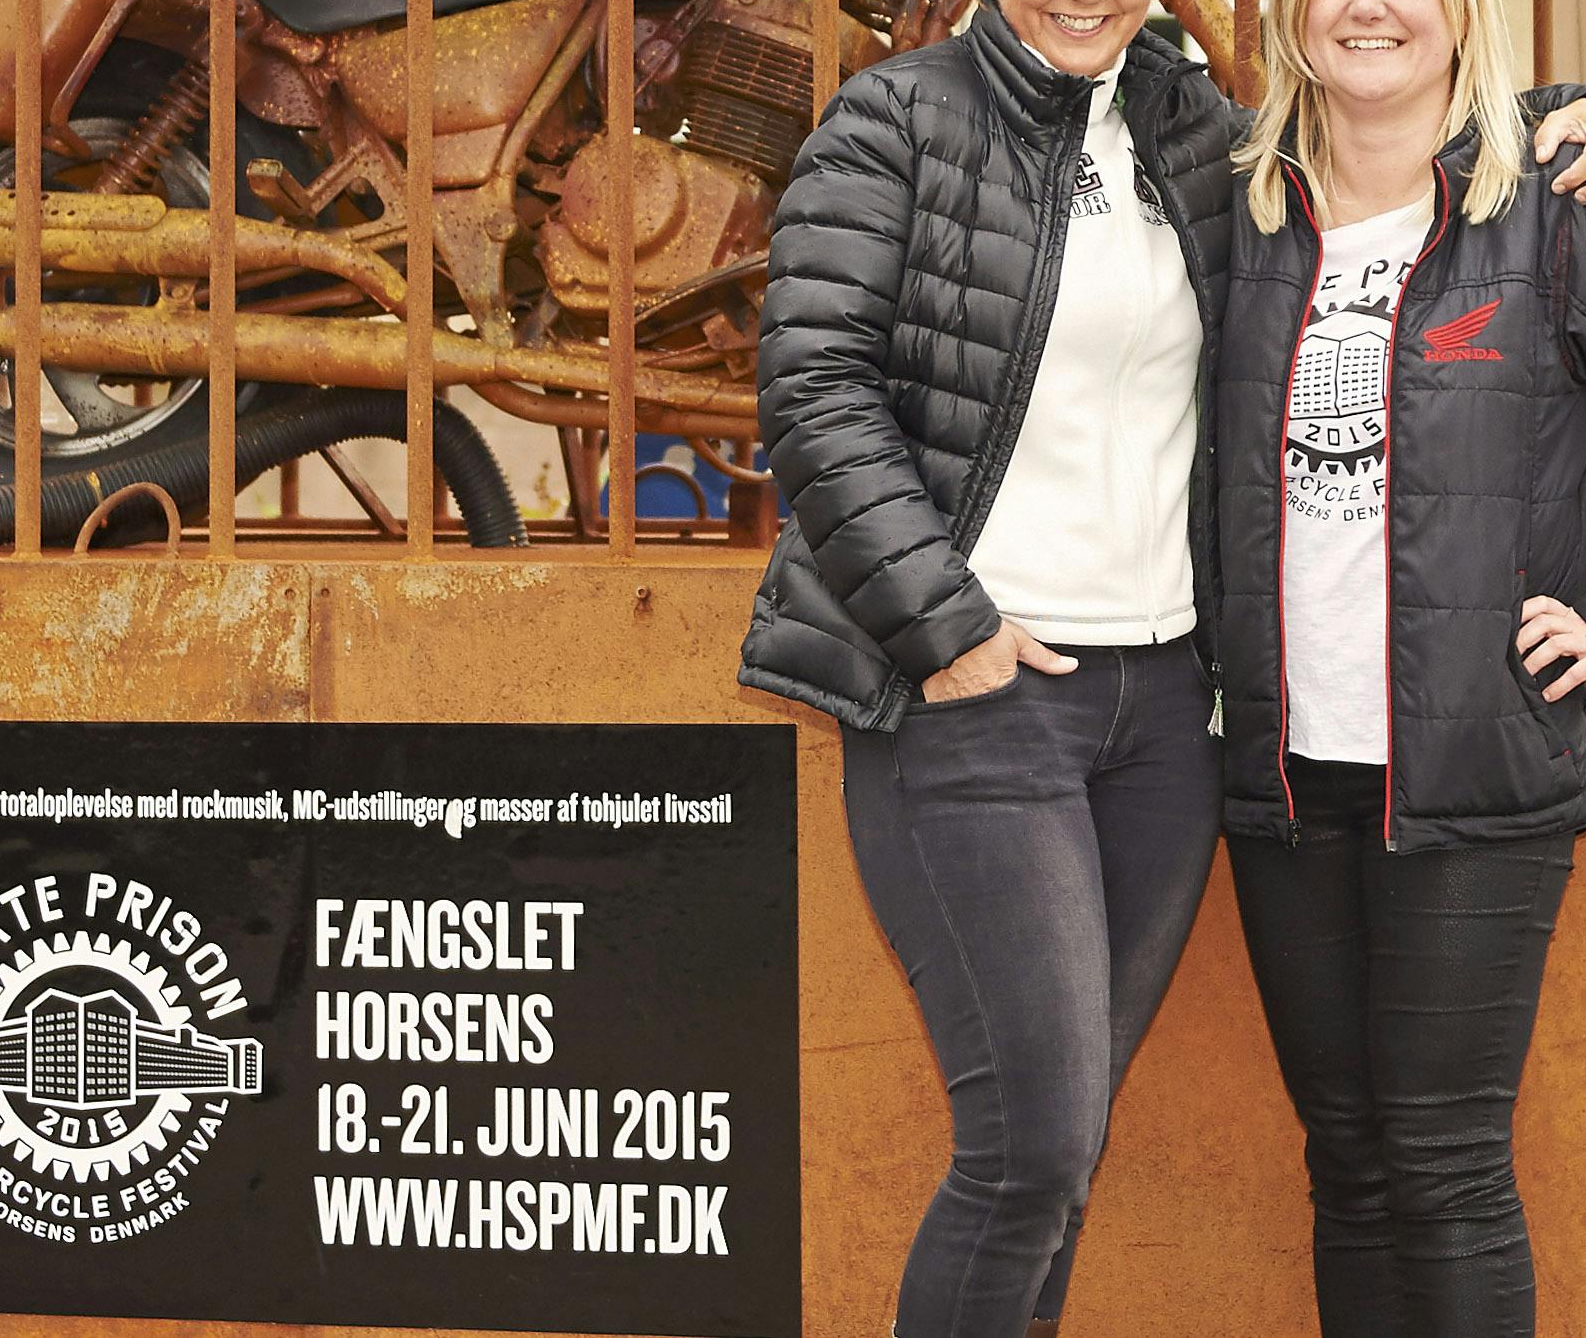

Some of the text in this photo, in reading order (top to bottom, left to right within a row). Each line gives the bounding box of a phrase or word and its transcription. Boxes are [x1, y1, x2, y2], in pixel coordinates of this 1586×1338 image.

[1423, 347, 1504, 362] HONDA
[1305, 417, 1382, 446] 2015
[1286, 489, 1331, 521] ORSENS
[0, 787, 133, 824] totaloplevelse
[137, 789, 179, 819] med
[182, 790, 289, 823] rockmusik,
[293, 790, 447, 828] MC-udstillinger
[480, 795, 551, 822] masser
[556, 793, 579, 822] af
[582, 793, 661, 828] tohjulet
[664, 793, 732, 823] livsstil
[85, 872, 248, 1020] PRISON
[316, 898, 584, 971] FÆNGSLET
[316, 990, 554, 1064] HORSENS
[36, 1107, 129, 1144] 2015
[318, 1082, 732, 1162] 18.-21. JUNI 2015
[119, 1098, 230, 1212] FESTIVAL
[90, 1192, 191, 1244] DENMARK
[314, 1176, 731, 1257] WWW.HSPMF.DK
